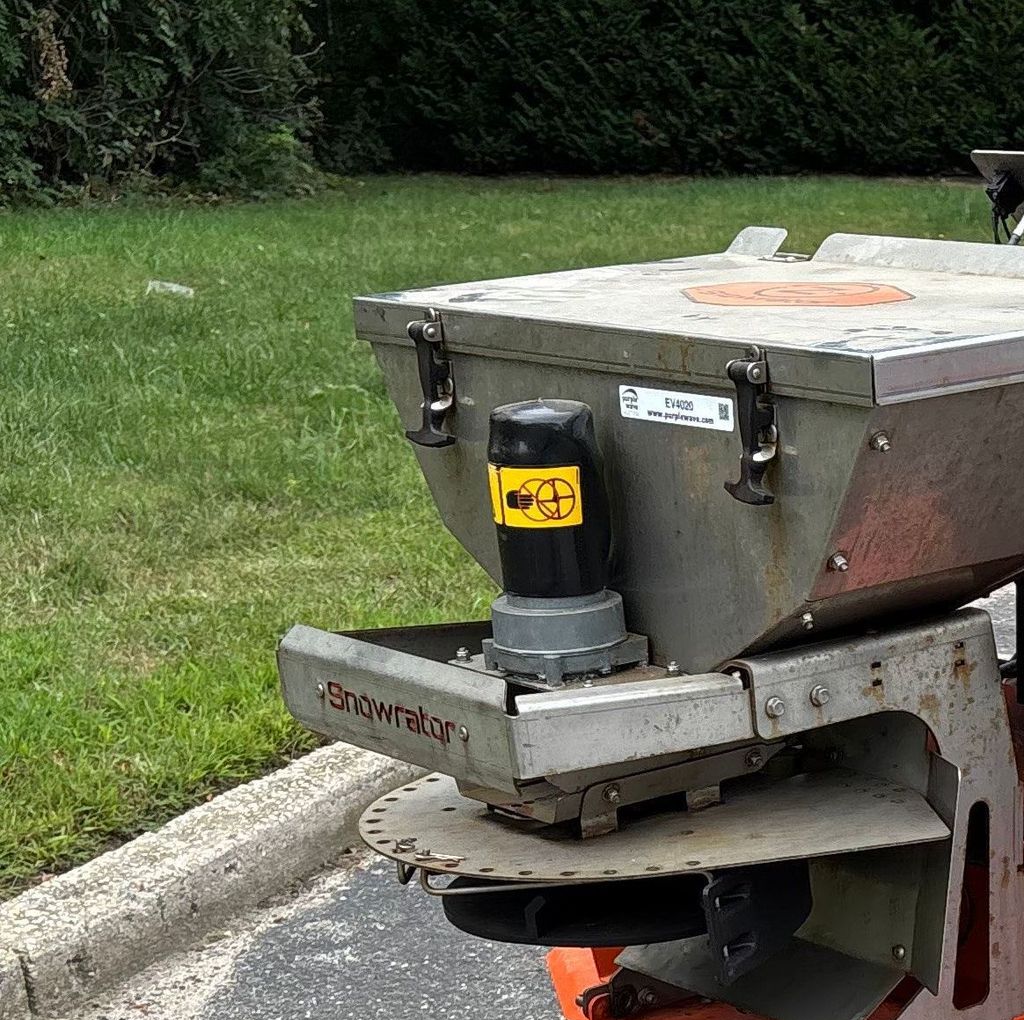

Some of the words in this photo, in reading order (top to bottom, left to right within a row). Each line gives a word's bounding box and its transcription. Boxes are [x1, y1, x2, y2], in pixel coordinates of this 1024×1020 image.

[665, 397, 693, 411] EV4020
[647, 409, 714, 424] www.purplewave.com
[326, 680, 457, 744] Snowrator
